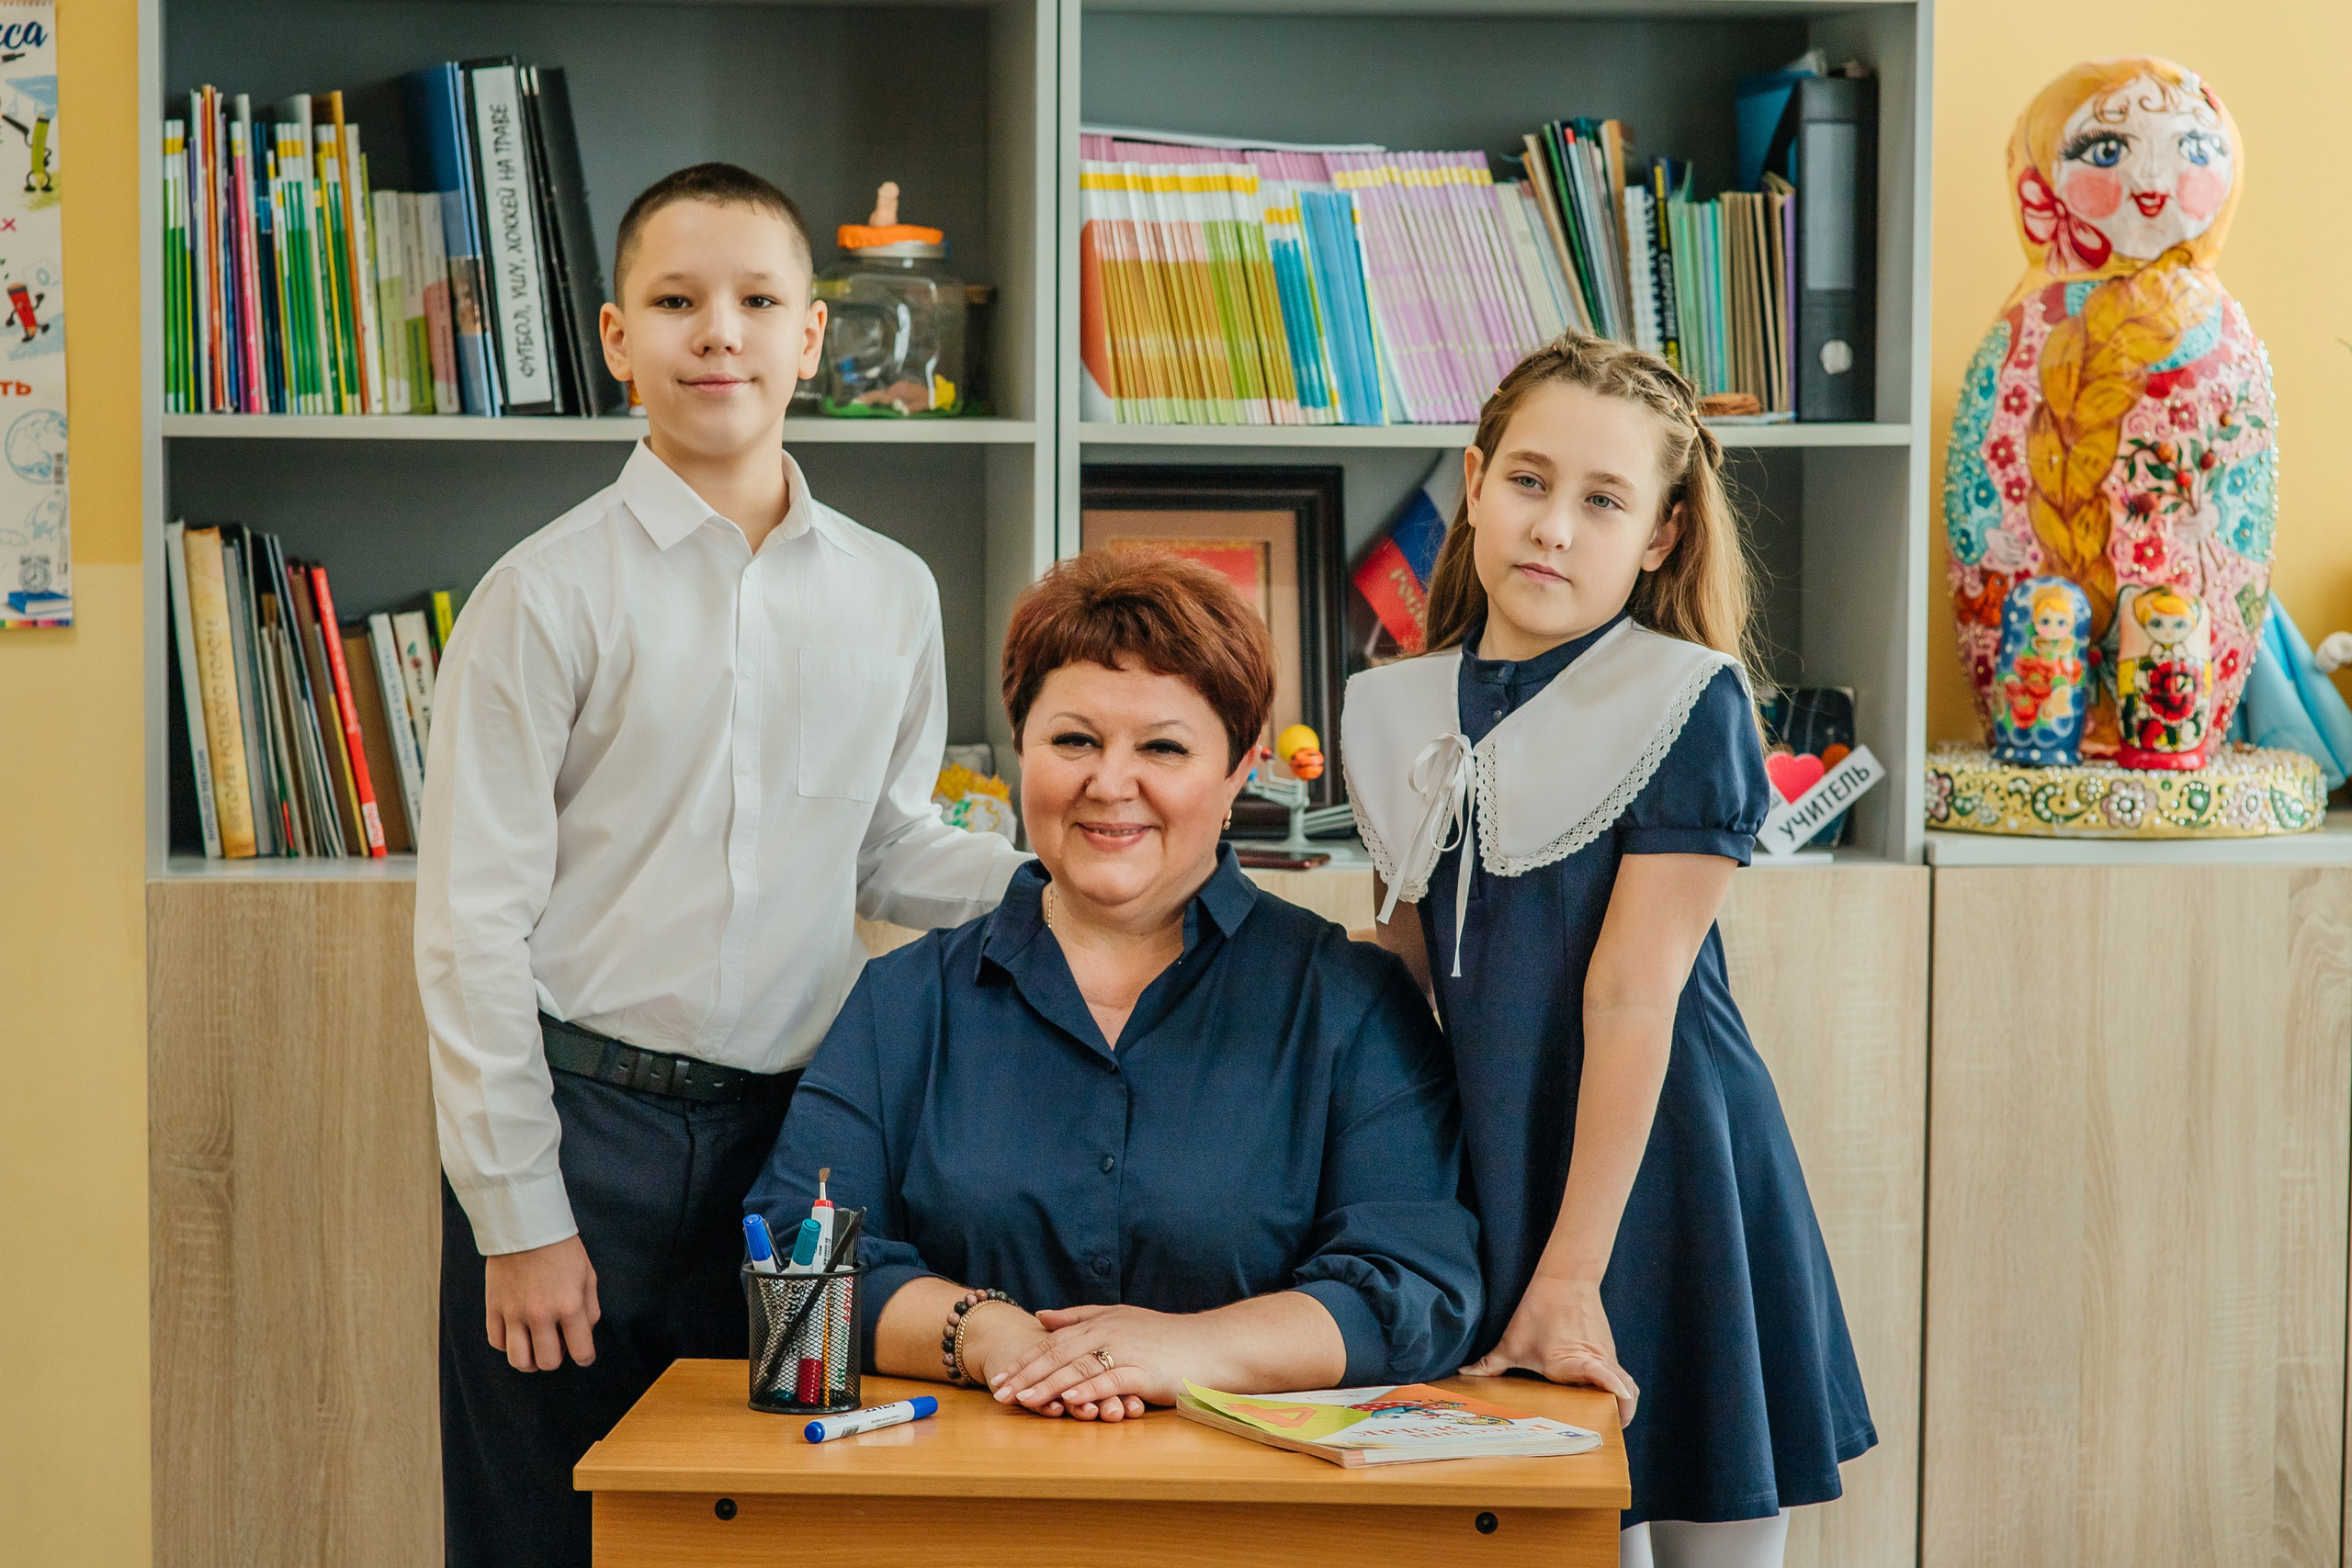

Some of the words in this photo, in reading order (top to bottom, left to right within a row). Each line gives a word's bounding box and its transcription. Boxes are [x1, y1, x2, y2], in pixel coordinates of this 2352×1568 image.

[0, 21, 48, 50] са
[489, 103, 512, 155] ТРАВЕ
[496, 158, 515, 182] НА
[496, 187, 523, 254] ХОККЕЙ
[508, 258, 528, 299] УШУ,
[513, 305, 536, 378] ФУТБОЛ,
[1779, 764, 1871, 842] УЧИТЕЛЬ
[1222, 1402, 1317, 1429] 4
